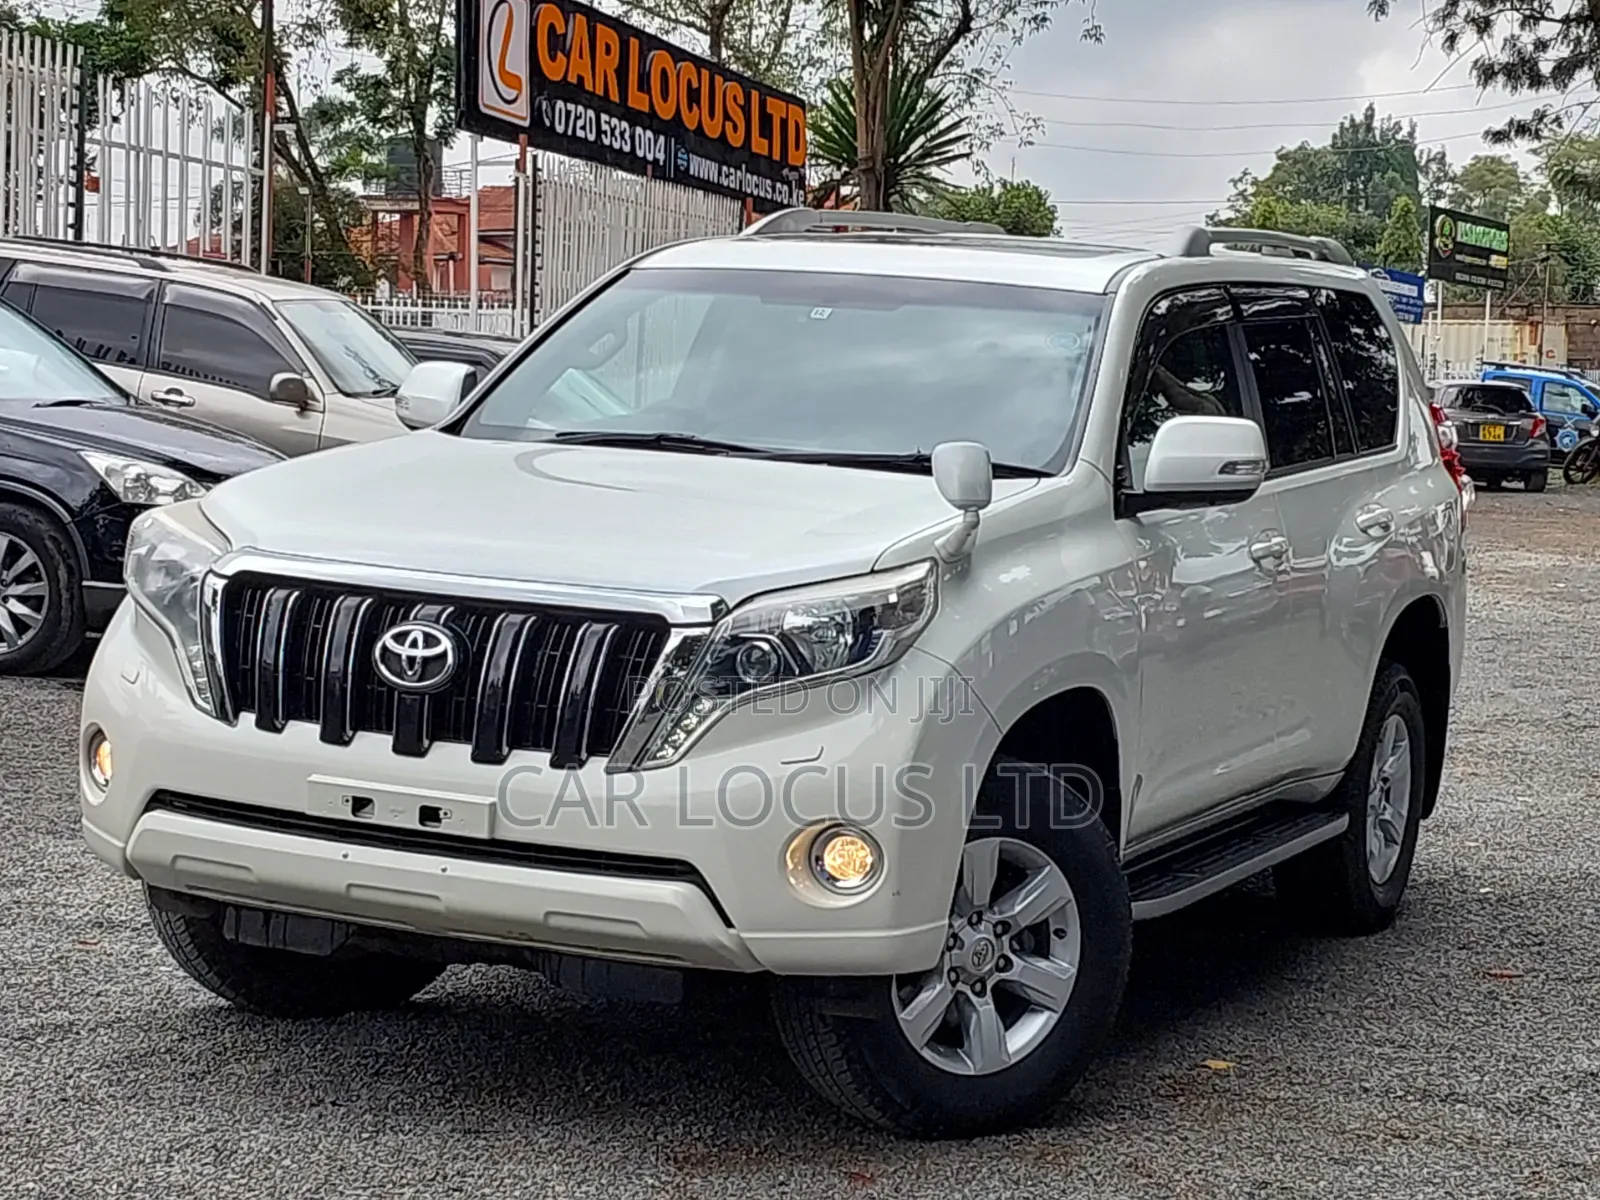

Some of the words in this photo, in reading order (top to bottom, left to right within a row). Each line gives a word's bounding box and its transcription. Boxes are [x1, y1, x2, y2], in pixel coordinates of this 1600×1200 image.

[536, 3, 620, 104] CAR
[627, 36, 746, 148] LOCUS
[751, 89, 807, 167] LTD
[554, 99, 596, 142] 0720
[600, 112, 631, 153] 533
[635, 126, 666, 167] 004
[689, 152, 806, 208] www.carlocus.co.ke
